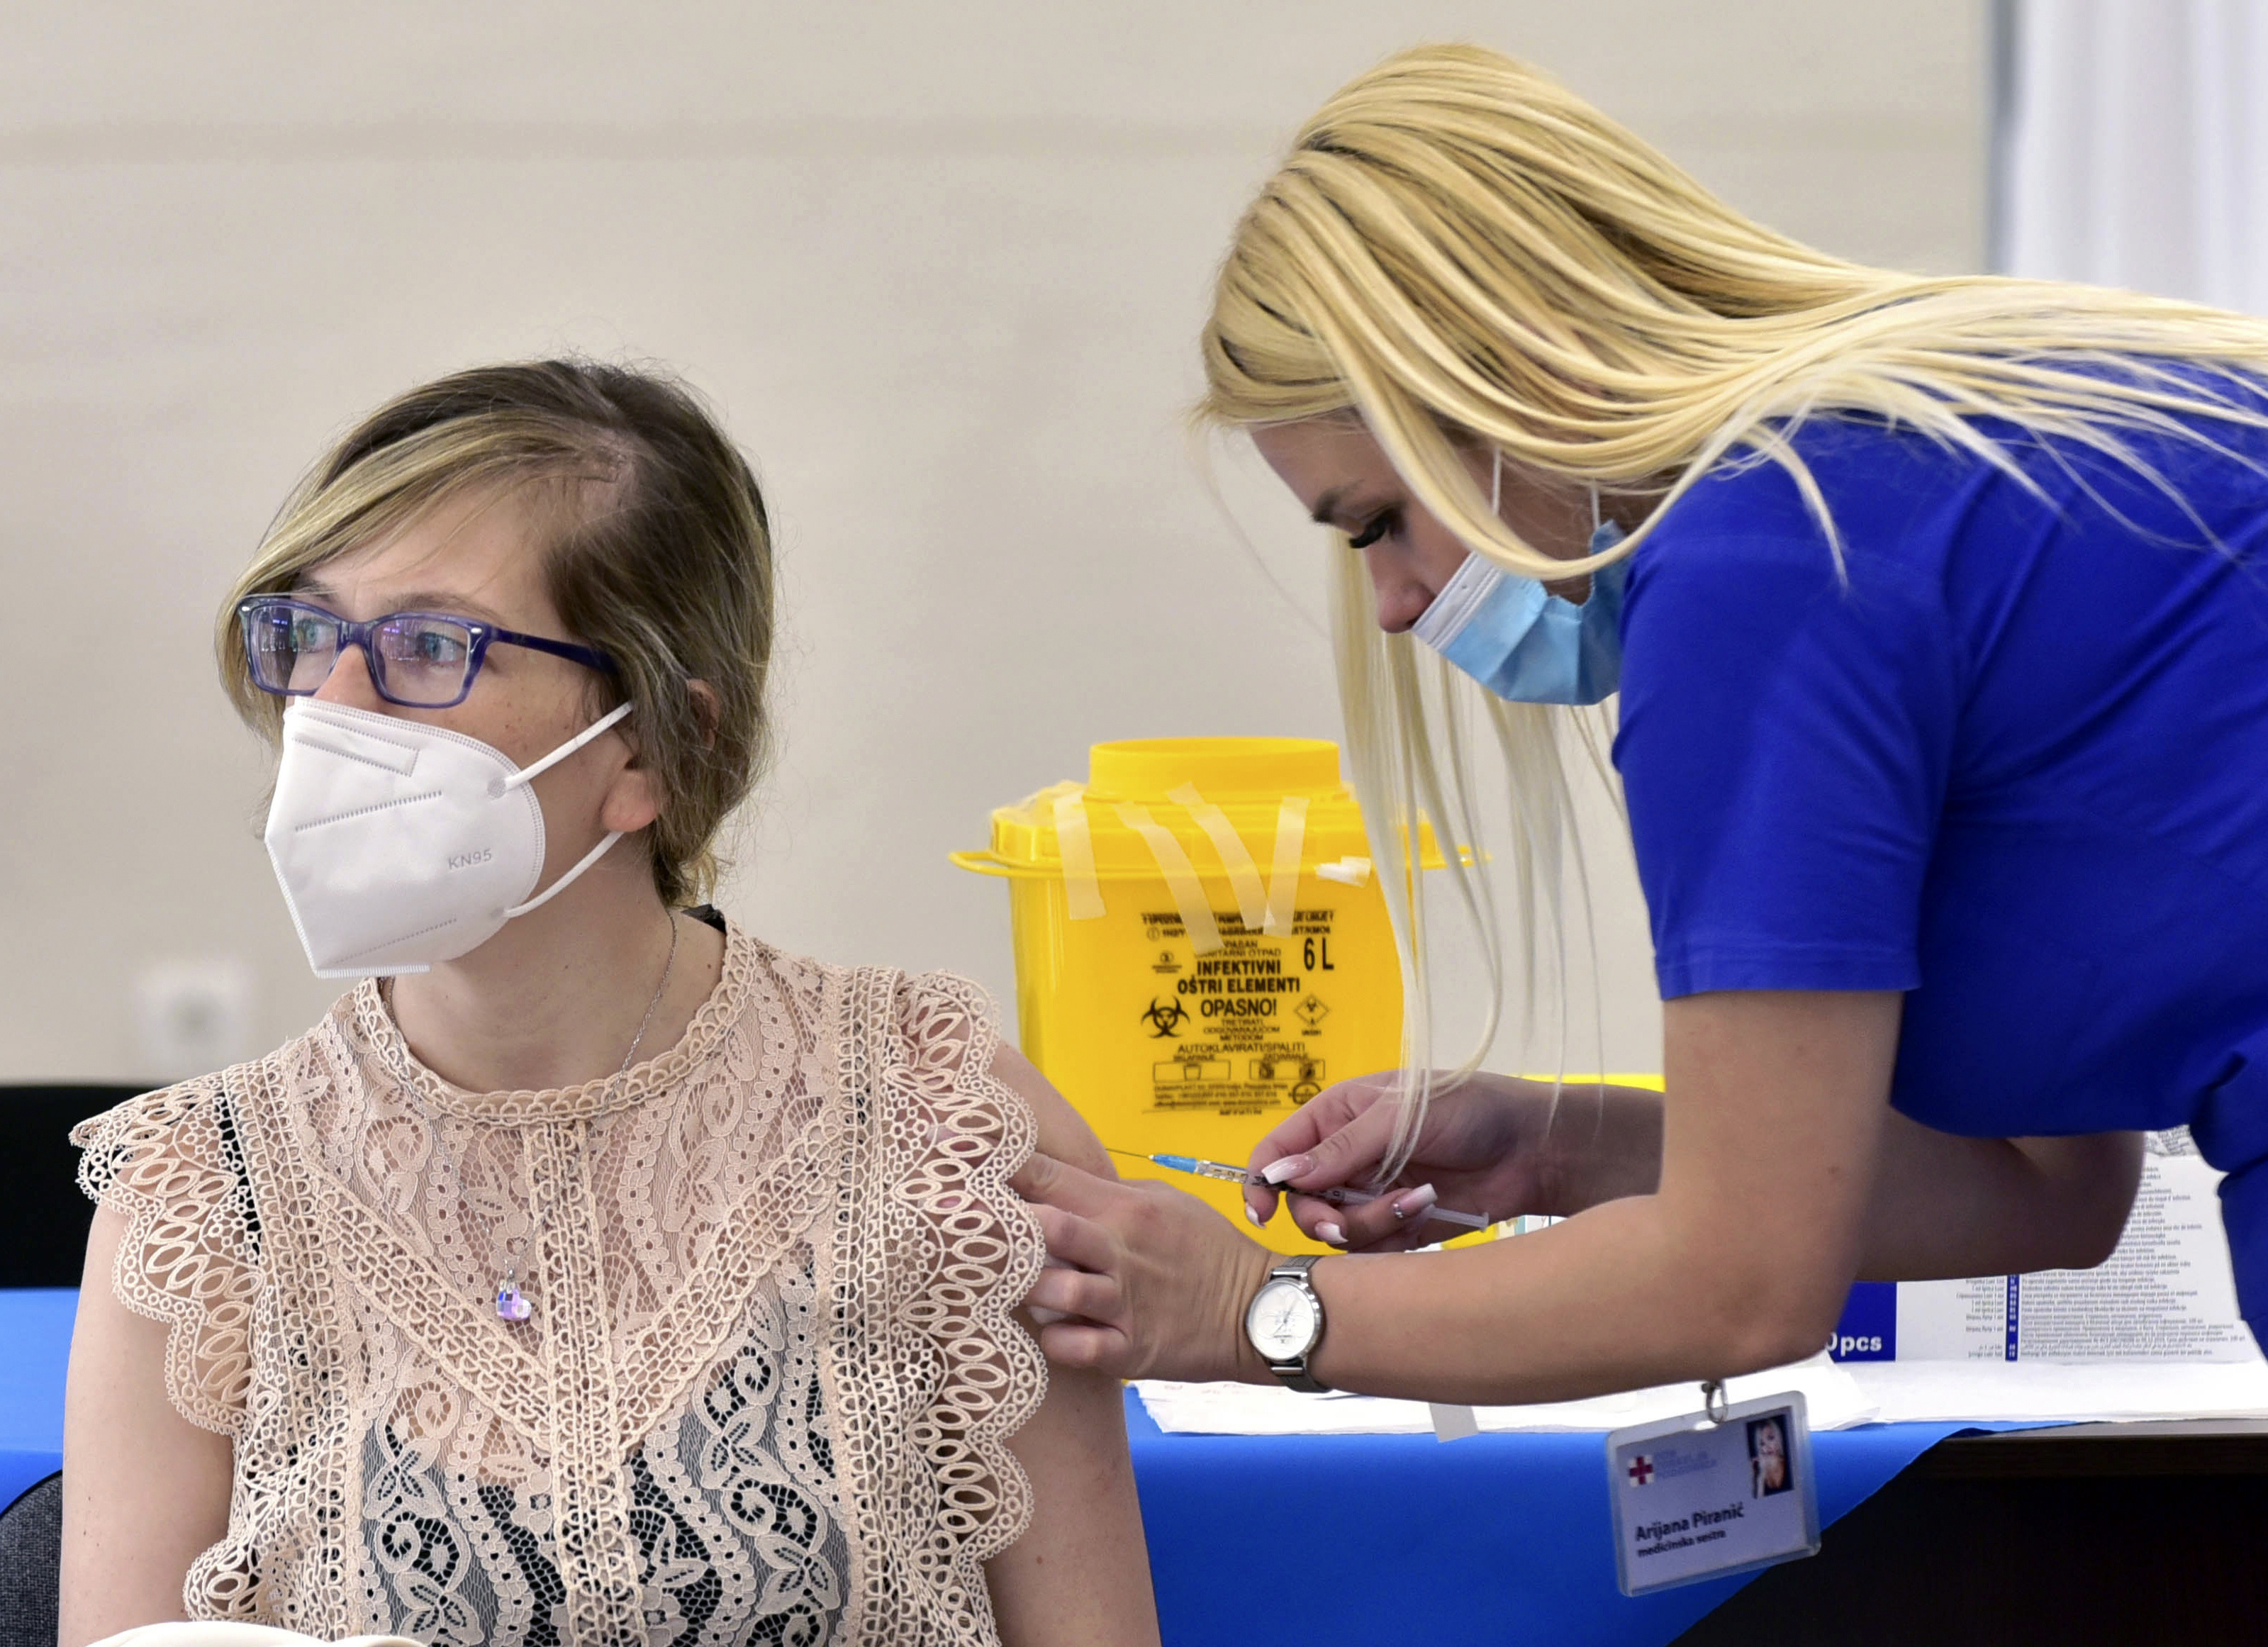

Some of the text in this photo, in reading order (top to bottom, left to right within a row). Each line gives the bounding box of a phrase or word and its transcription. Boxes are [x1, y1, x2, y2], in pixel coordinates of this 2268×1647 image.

[448, 849, 492, 870] KN95
[1248, 948, 1282, 957] OTPAD
[1304, 936, 1334, 971] 6 L
[1197, 959, 1281, 976] INFEKTIVNI
[1177, 974, 1300, 995] OŠTRI ELEMENTI
[1200, 998, 1278, 1017] OPASNO!
[1636, 1502, 1745, 1541] Arijana Piranić
[1637, 1530, 1727, 1558] medicinska sestra
